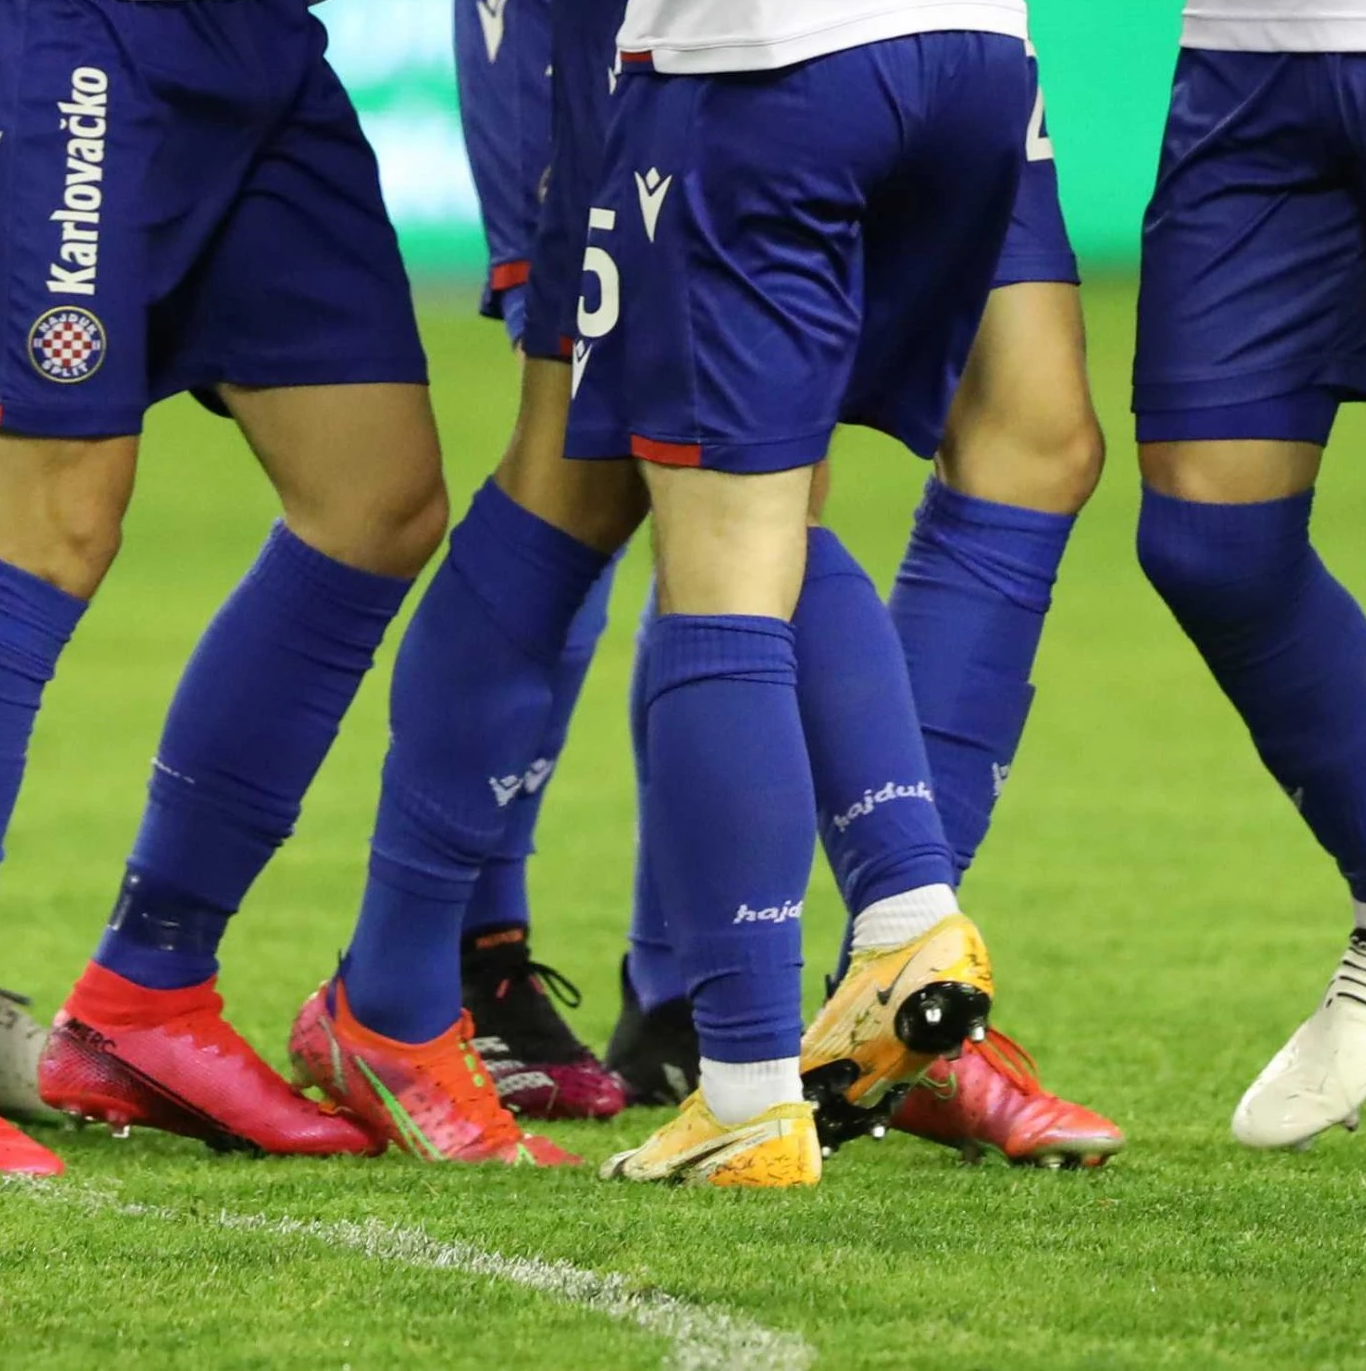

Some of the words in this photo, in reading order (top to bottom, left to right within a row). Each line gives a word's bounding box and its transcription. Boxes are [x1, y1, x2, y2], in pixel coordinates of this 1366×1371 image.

[45, 66, 108, 295] Karlovačko
[577, 207, 619, 338] 5
[42, 359, 88, 377] SPLIT
[833, 780, 933, 833] hajduk
[733, 900, 803, 924] hajd
